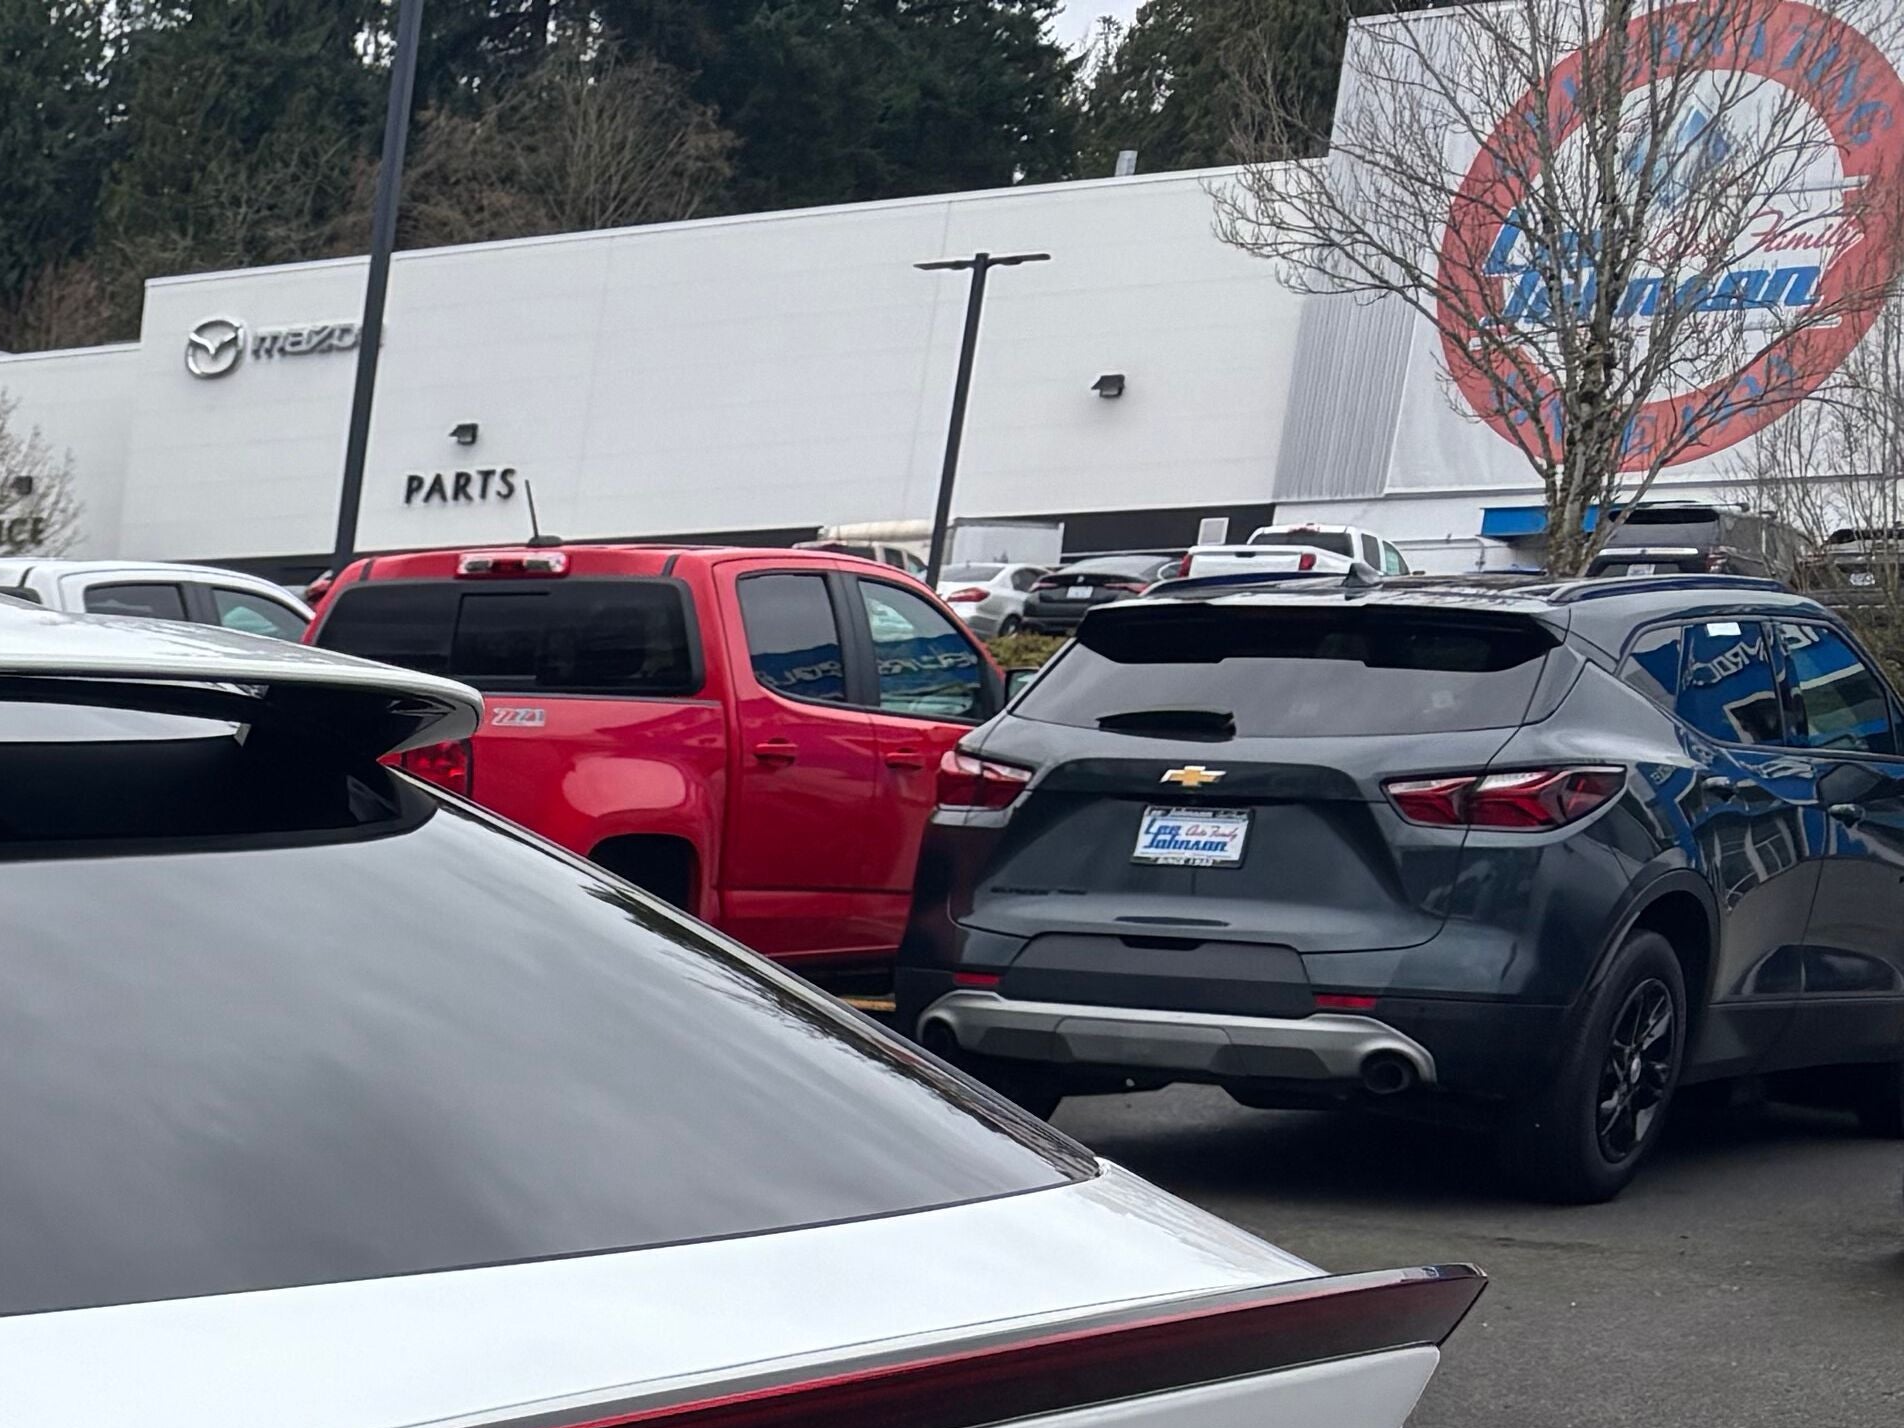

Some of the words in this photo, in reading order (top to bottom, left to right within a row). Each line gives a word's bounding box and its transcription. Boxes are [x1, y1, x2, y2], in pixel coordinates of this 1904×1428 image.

[1751, 208, 1865, 270] Family
[405, 468, 516, 504] PARTS
[1144, 818, 1182, 836] Lee
[1142, 832, 1228, 853] Johnson
